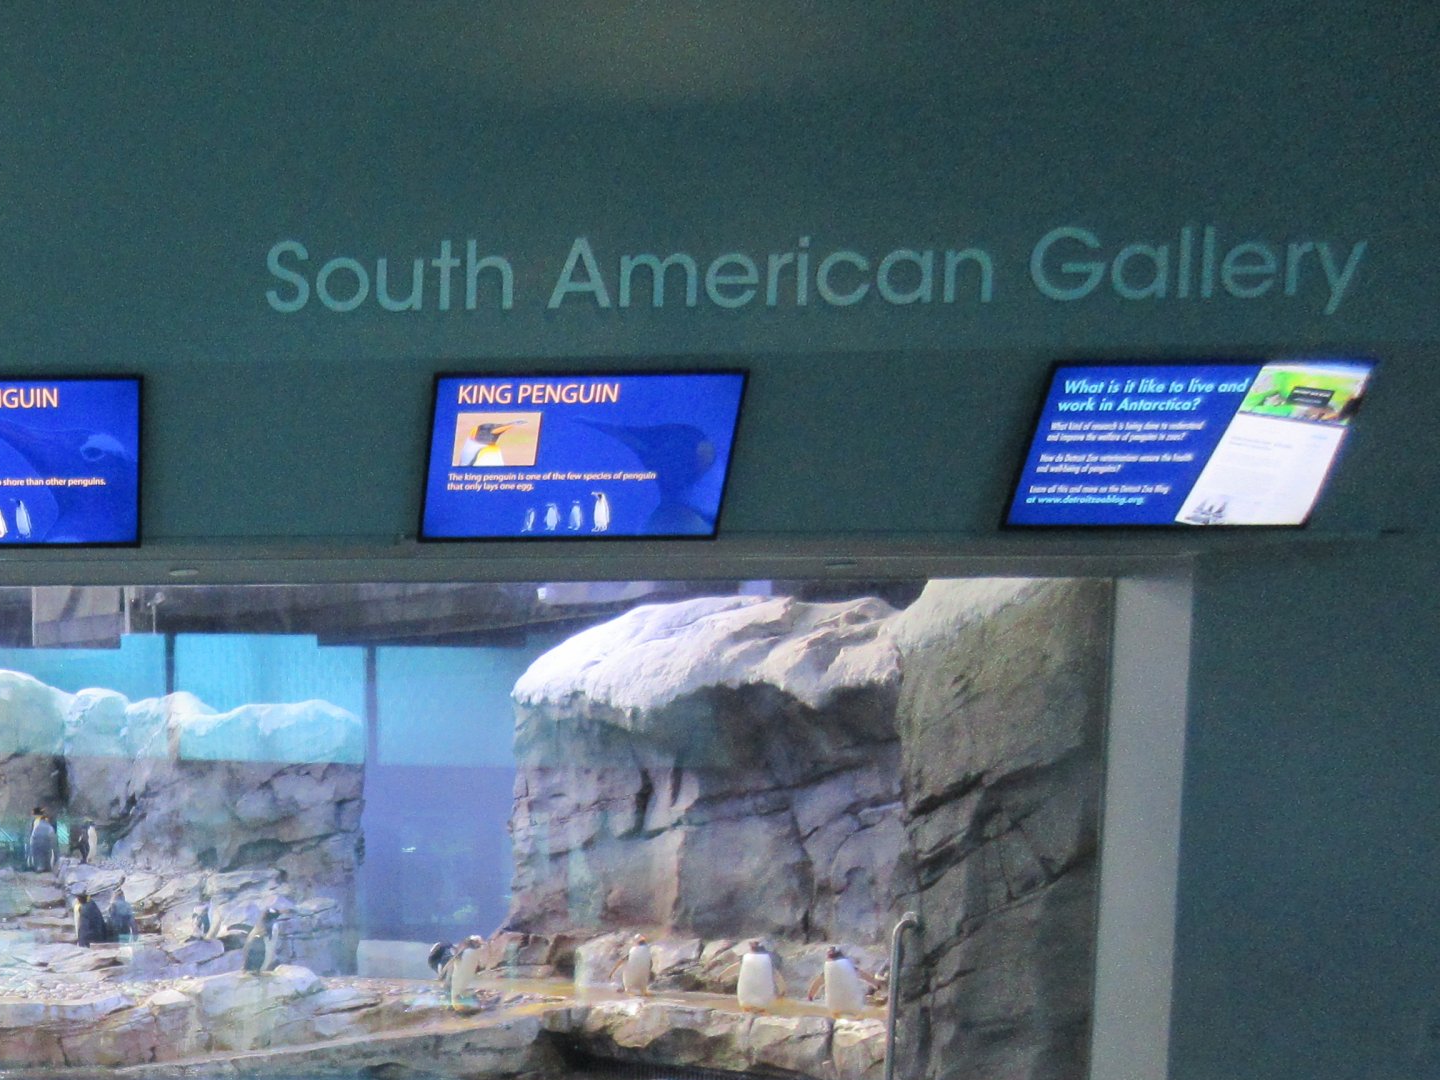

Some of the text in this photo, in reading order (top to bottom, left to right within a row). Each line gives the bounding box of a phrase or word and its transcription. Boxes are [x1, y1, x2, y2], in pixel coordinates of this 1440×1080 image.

[265, 226, 1368, 316] South American Gallery
[1064, 377, 1251, 394] What is it like to live and
[457, 383, 620, 404] KING PENGUIN
[1058, 397, 1202, 411] work in Antarctica?
[2, 477, 24, 487] shore
[26, 477, 44, 486] than
[45, 477, 66, 486] other
[67, 477, 106, 487] penguins.
[448, 473, 463, 481] The
[464, 472, 481, 482] king
[483, 472, 516, 482] penguin
[517, 472, 524, 480] is
[542, 472, 552, 480] of
[552, 472, 566, 480] the
[567, 472, 582, 480] few
[583, 472, 612, 481] species
[612, 471, 623, 480] of
[623, 472, 657, 481] penguin
[447, 482, 463, 490] that
[464, 482, 482, 492] only
[483, 482, 499, 491] lays
[516, 483, 534, 491] egg.
[1026, 494, 1145, 505] at www.detroitzooblog.org
